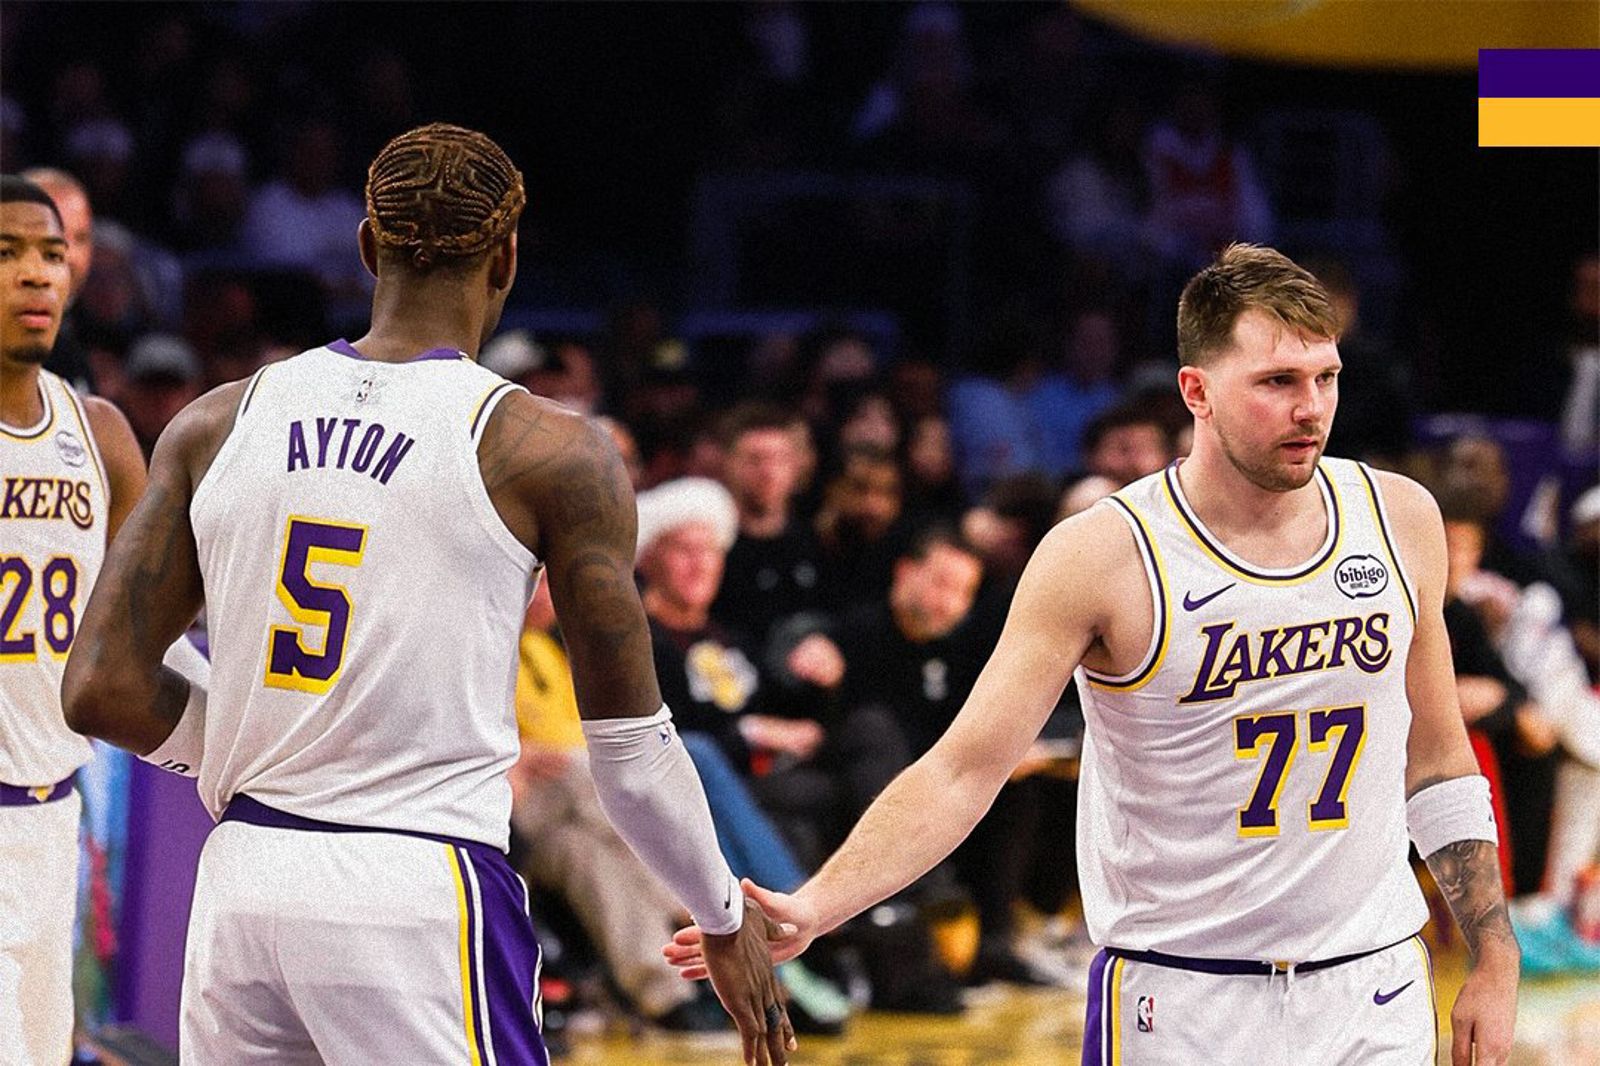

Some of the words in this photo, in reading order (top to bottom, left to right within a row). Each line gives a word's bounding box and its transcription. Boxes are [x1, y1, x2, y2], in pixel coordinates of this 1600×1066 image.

[287, 417, 415, 486] AYTON
[0, 554, 79, 663] 28
[264, 514, 369, 695] 5
[1339, 565, 1385, 584] bibigo
[1177, 612, 1393, 706] LAKERS
[1233, 703, 1368, 838] 77
